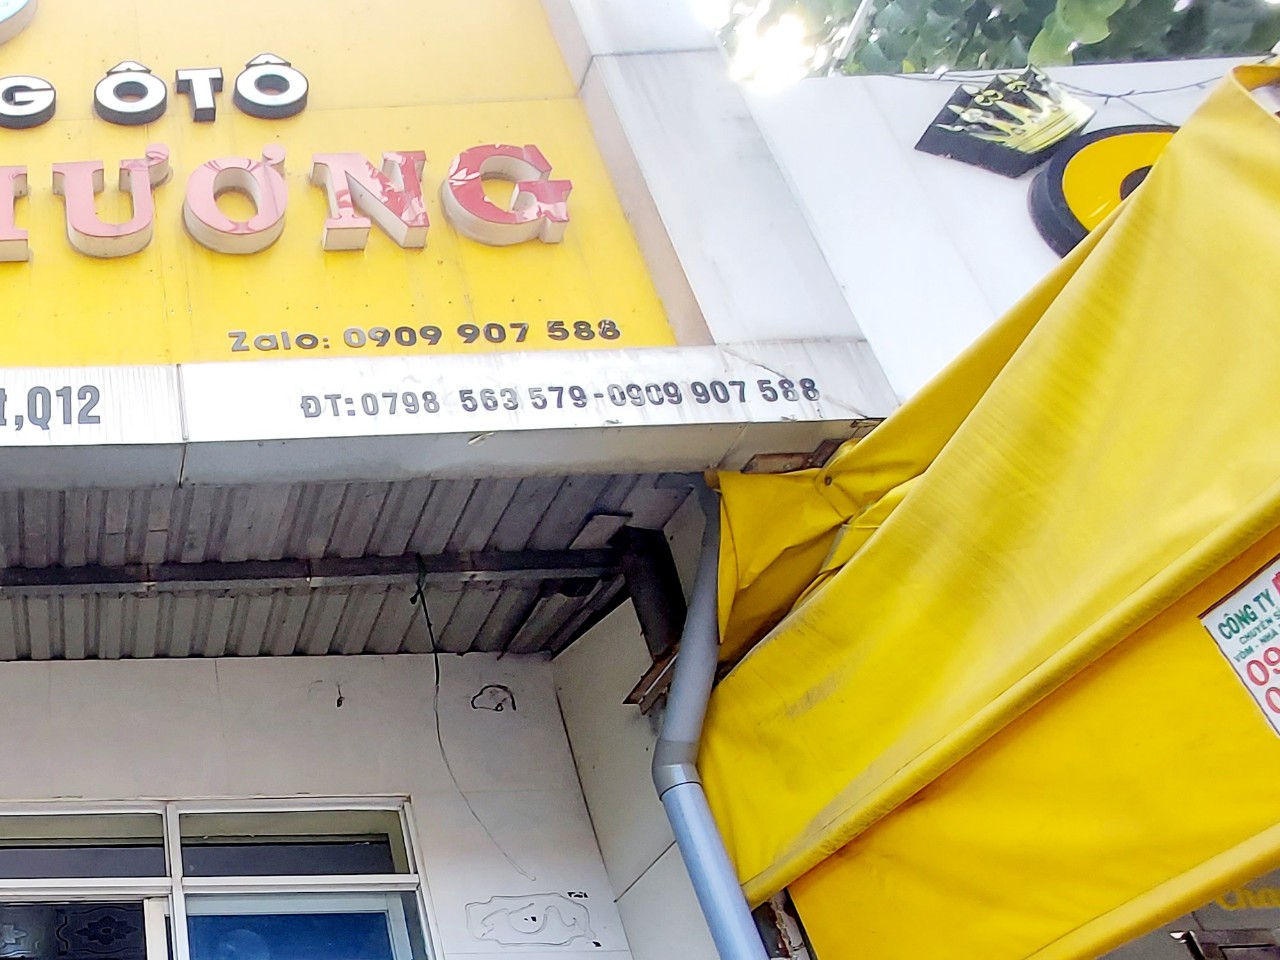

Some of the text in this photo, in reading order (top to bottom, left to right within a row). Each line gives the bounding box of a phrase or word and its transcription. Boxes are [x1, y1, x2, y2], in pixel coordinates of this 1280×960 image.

[93, 52, 309, 126] ÔTÔ
[228, 319, 621, 354] Zalo: 0909 907 588
[459, 387, 520, 412] 563
[691, 380, 747, 404] 907
[758, 378, 821, 402] 588
[1218, 604, 1258, 640] CÔNG
[1253, 588, 1276, 613] TY
